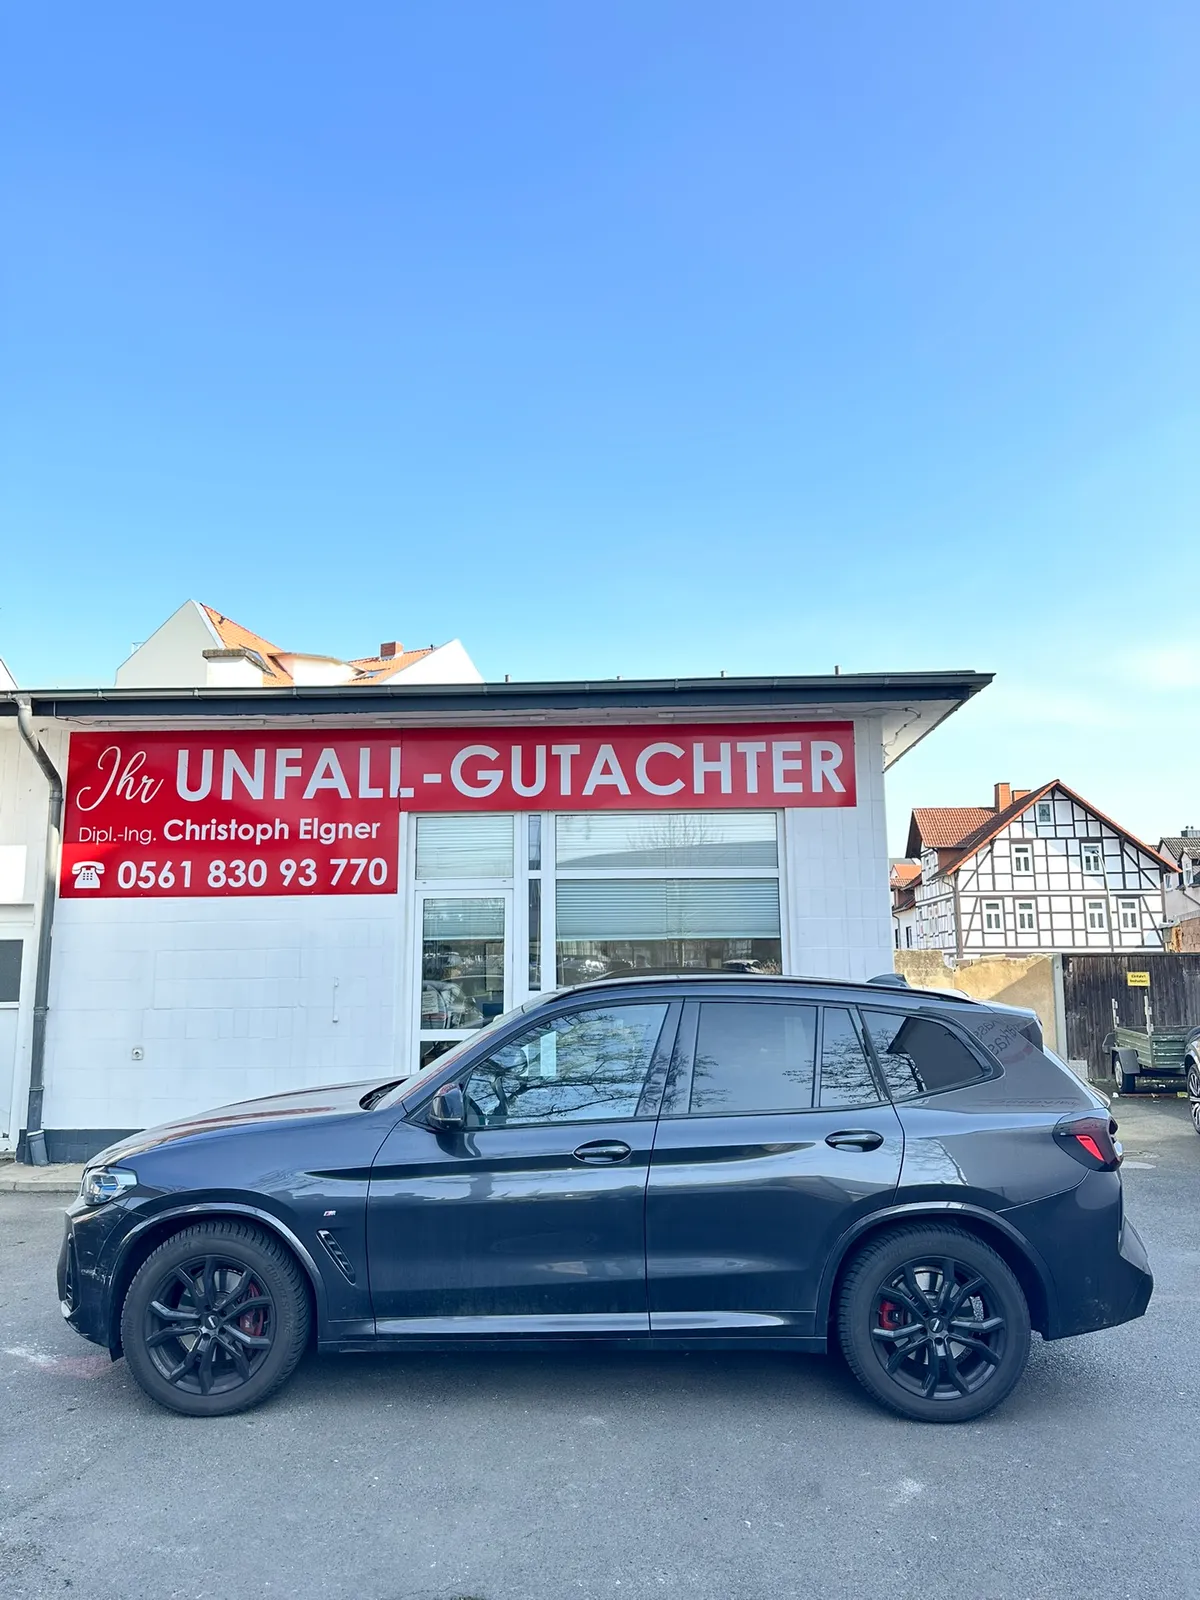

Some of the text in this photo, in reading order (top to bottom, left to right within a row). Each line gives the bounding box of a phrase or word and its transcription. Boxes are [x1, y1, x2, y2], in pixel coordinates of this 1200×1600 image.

[76, 740, 847, 812] Ihr UNFALL-GUTACHTER
[78, 817, 381, 846] Dipl.-Ing. Christoph Elgner
[117, 857, 388, 890] 0561 830 93 770
